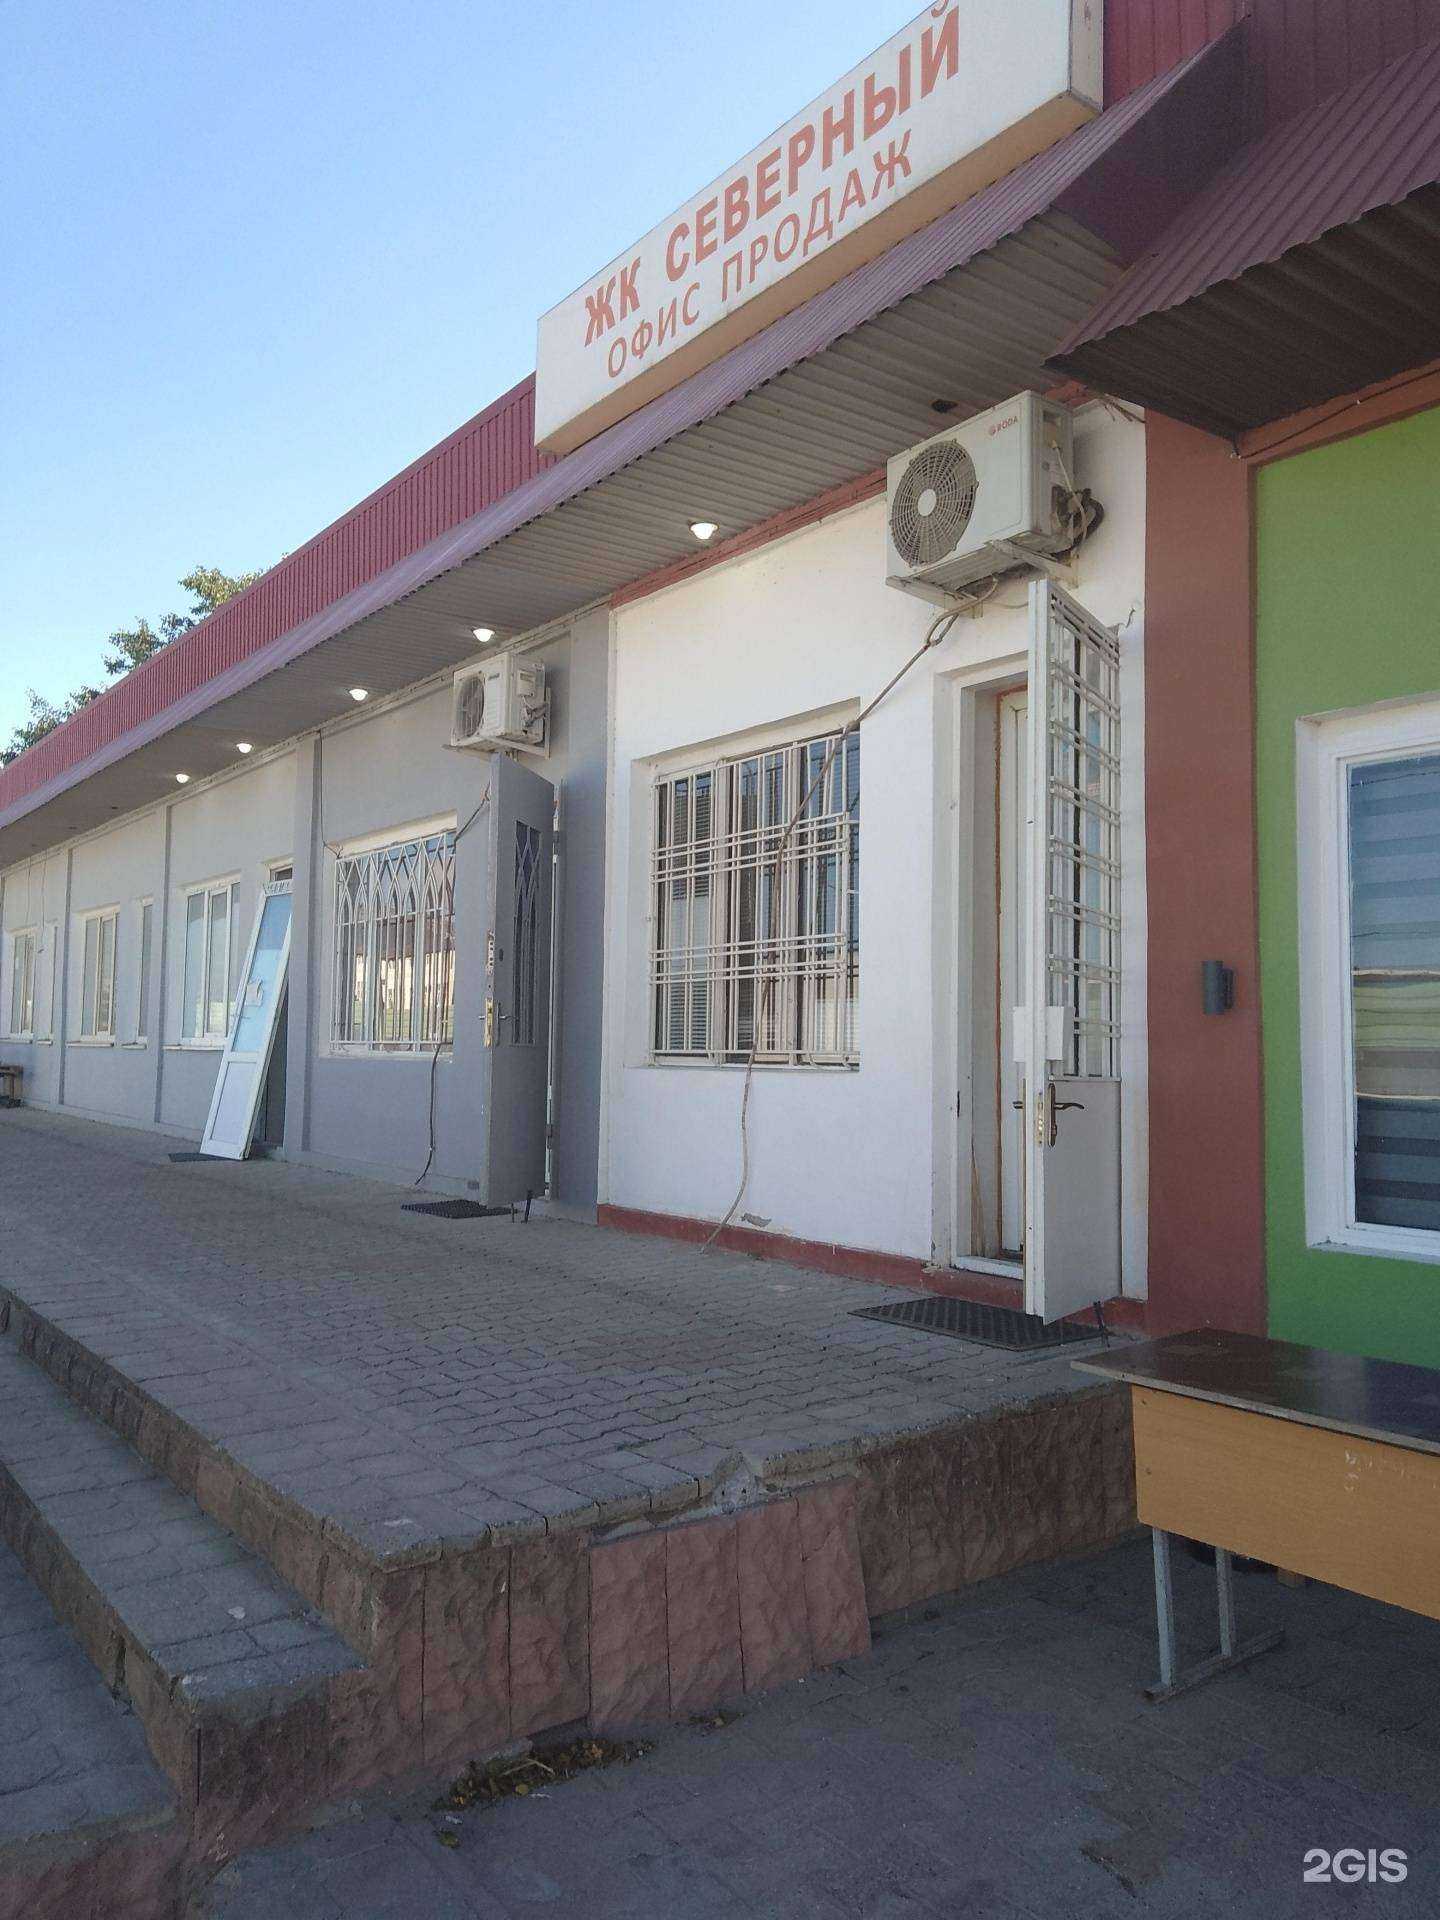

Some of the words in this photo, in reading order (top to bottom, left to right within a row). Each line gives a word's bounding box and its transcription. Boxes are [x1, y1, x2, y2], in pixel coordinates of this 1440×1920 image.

[585, 257, 640, 346] ЖК
[667, 0, 959, 281] СЕВЕРНЫЙ
[609, 283, 700, 378] ОФИС
[722, 130, 912, 301] ПРОДАЖ
